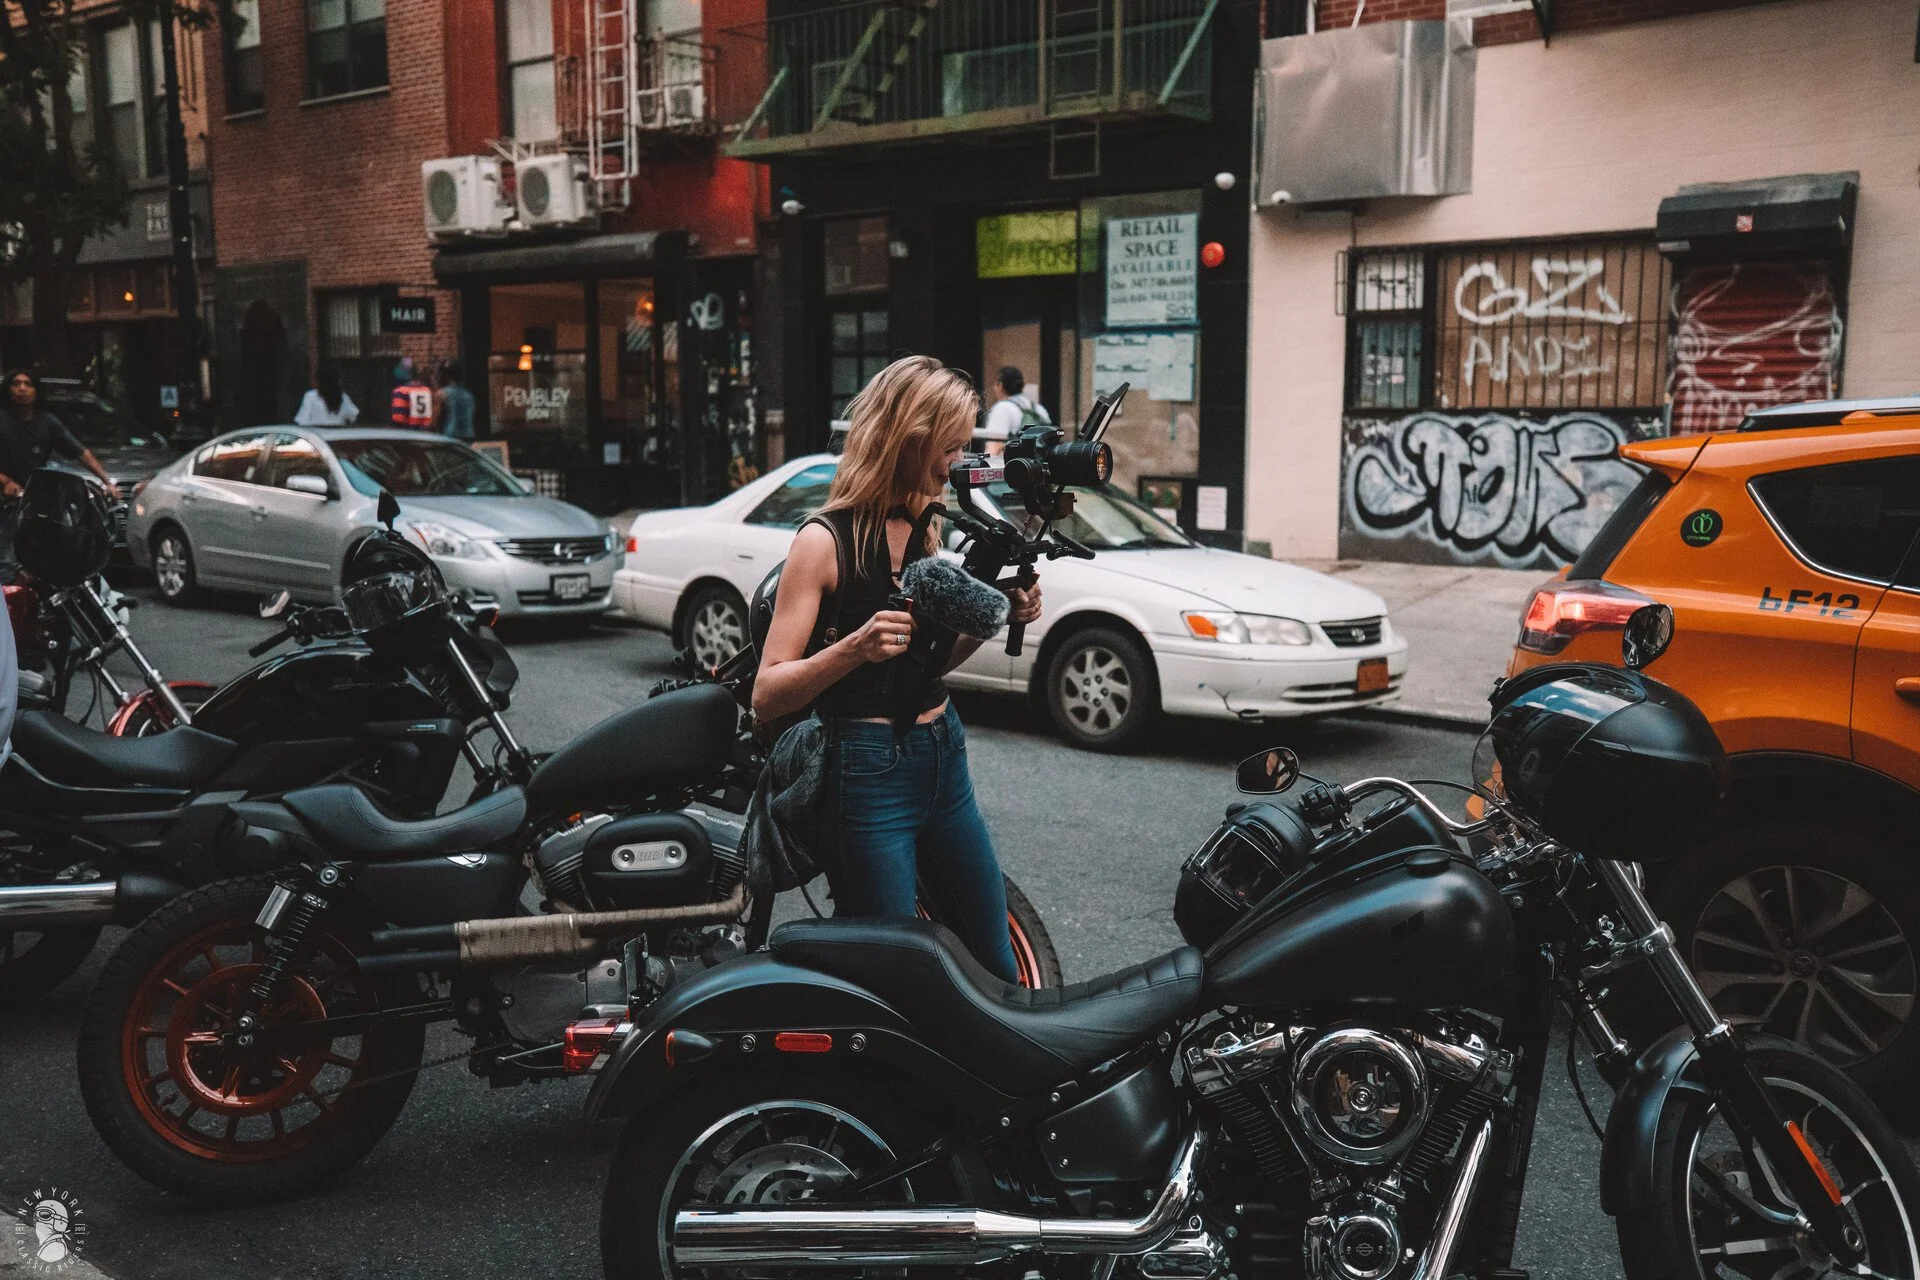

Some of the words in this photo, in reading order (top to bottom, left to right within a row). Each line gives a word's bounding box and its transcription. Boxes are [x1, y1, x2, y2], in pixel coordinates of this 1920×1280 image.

[1121, 218, 1184, 237] RETAIL
[1125, 240, 1179, 258] SPACE
[391, 307, 426, 321] HAIR
[416, 395, 427, 414] 5
